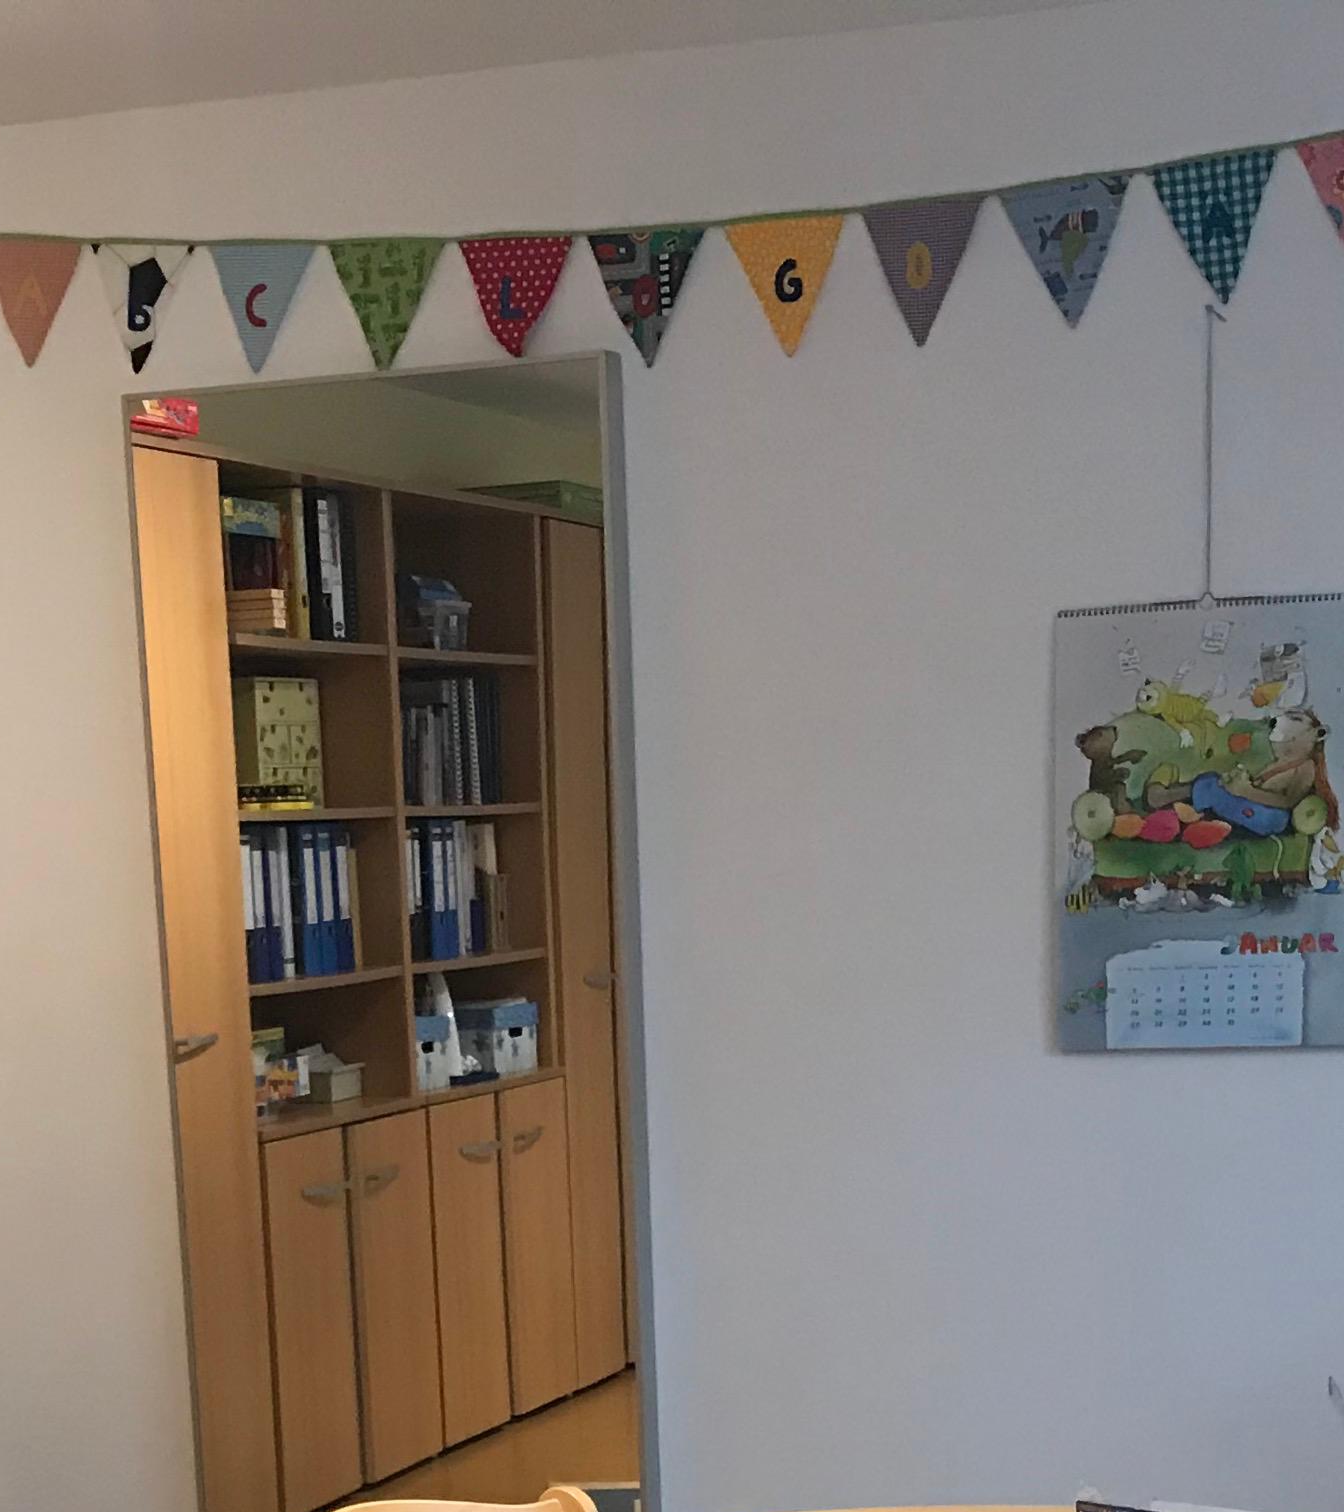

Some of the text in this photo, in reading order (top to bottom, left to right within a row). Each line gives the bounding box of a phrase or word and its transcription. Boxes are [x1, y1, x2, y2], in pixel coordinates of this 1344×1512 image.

[244, 282, 268, 328] C
[499, 274, 525, 320] L
[775, 257, 804, 303] G
